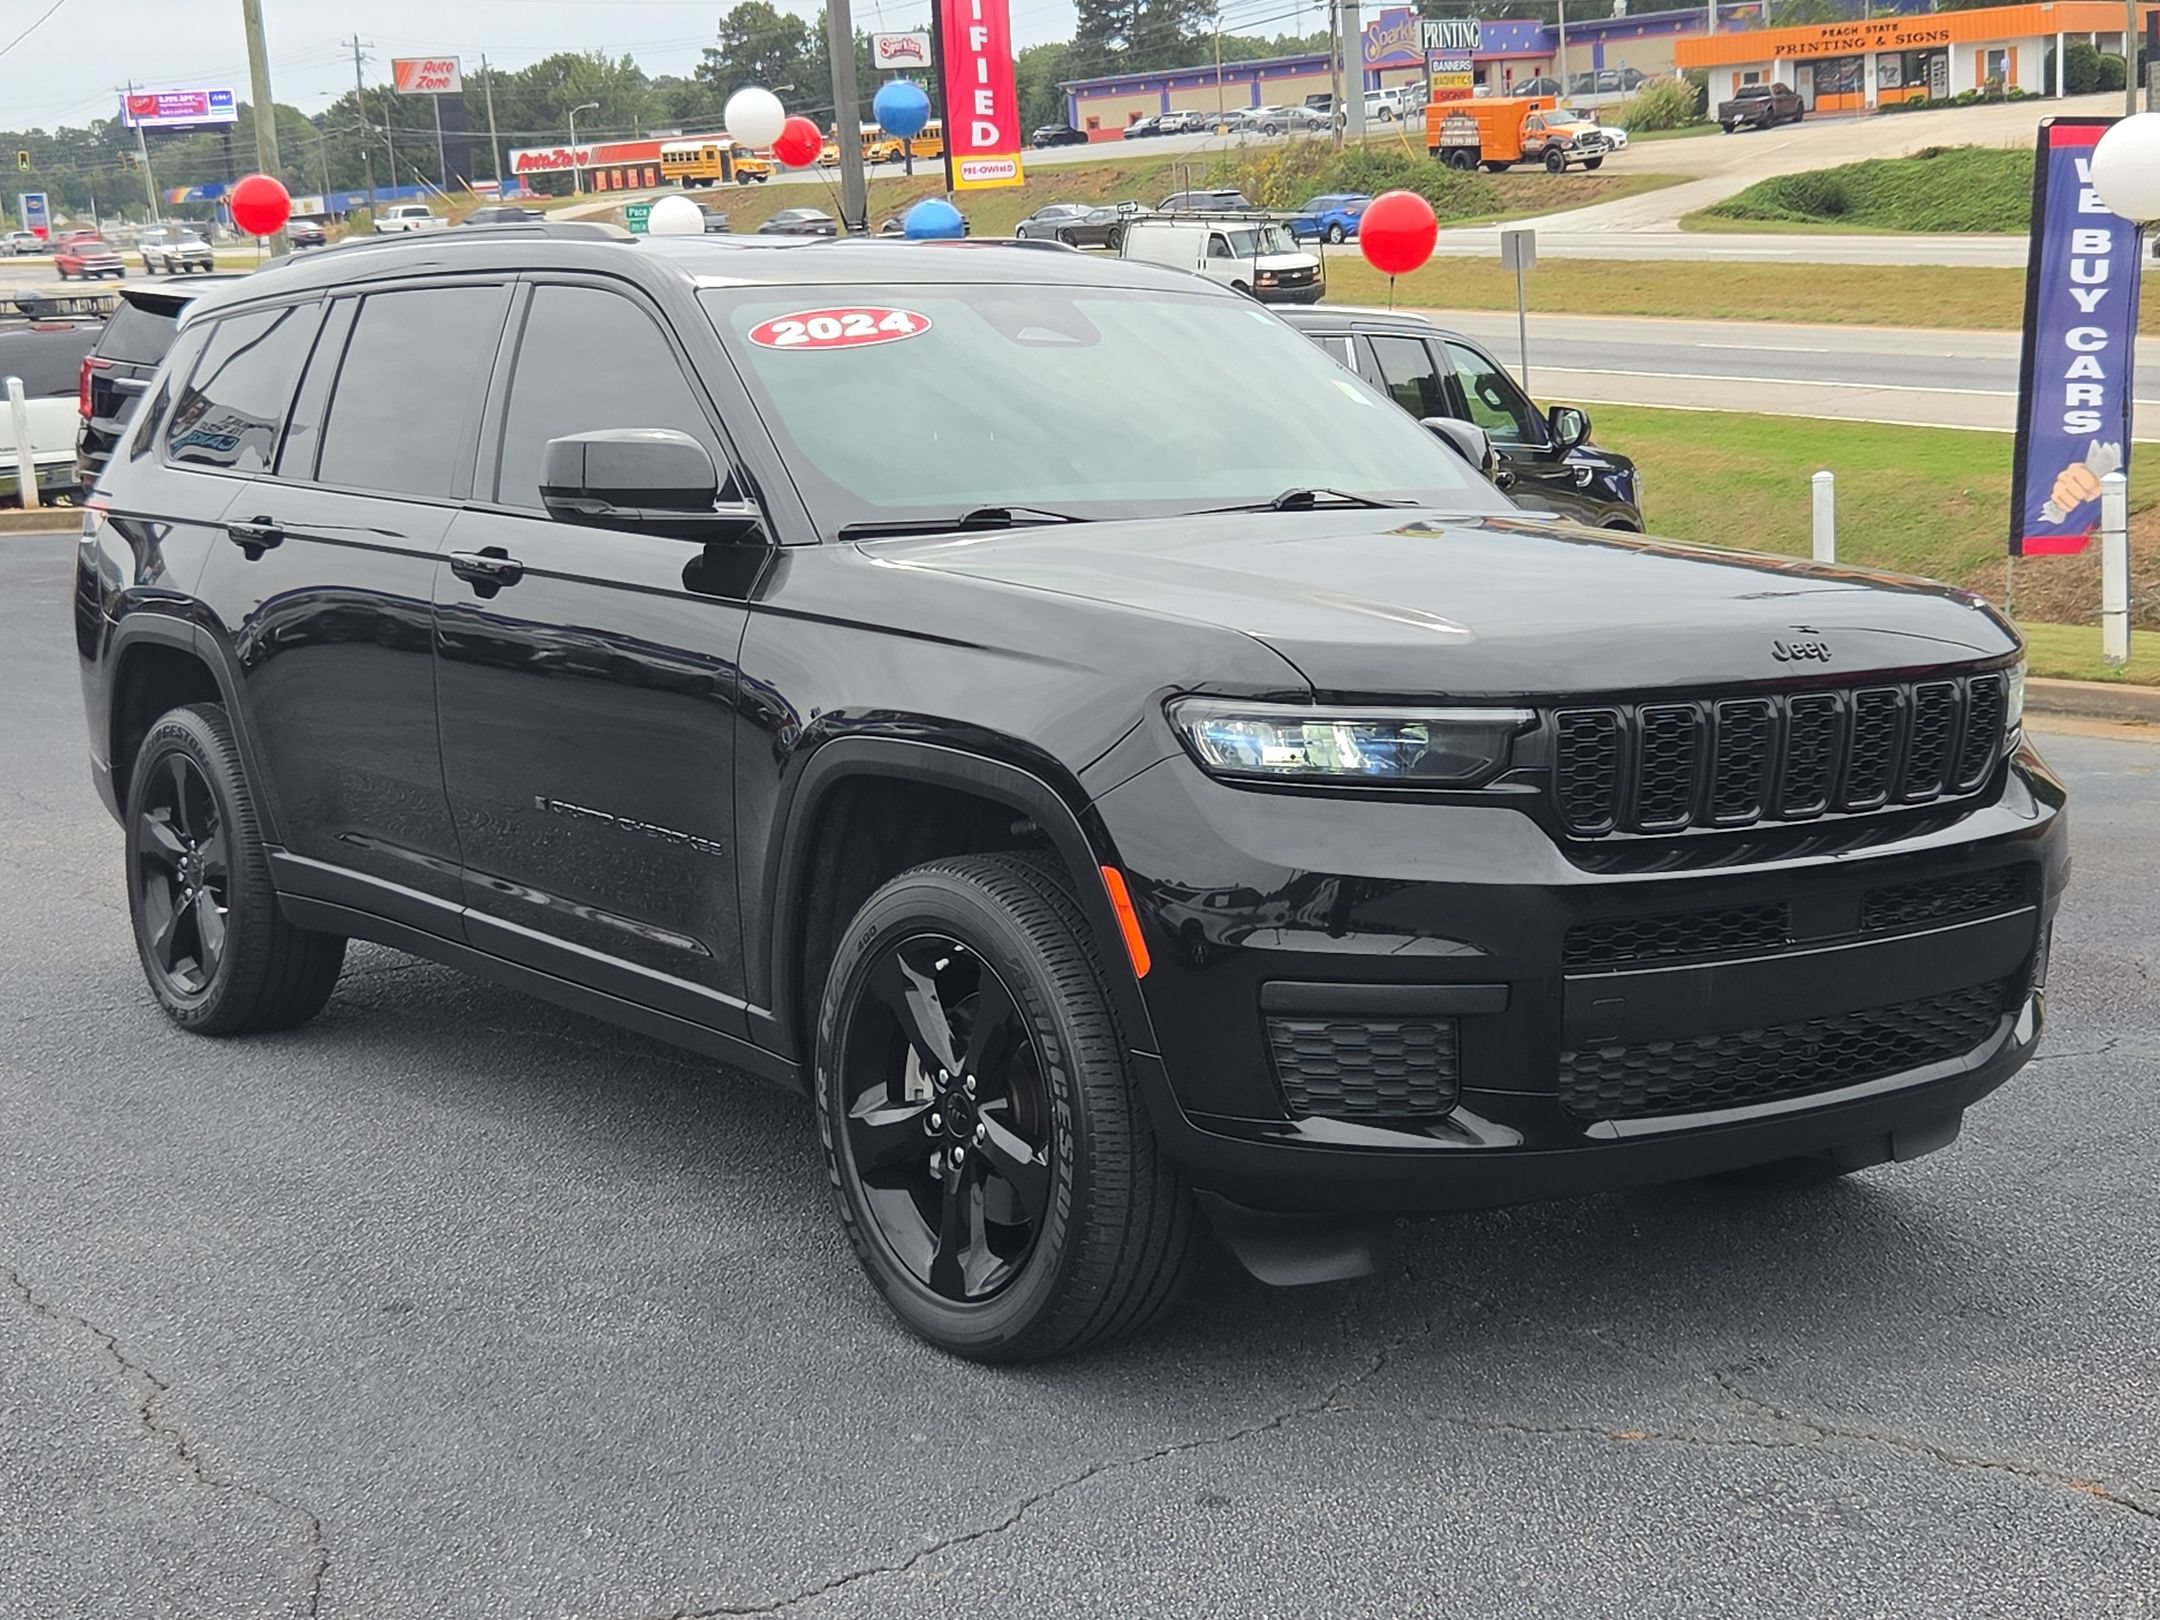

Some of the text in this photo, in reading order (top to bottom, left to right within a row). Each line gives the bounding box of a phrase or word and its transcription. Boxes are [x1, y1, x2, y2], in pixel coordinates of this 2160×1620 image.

[1422, 21, 1480, 49] PRINTING
[1773, 30, 1950, 55] PRINTING & SIGNS
[1821, 23, 1899, 38] PEACH STATE
[422, 60, 455, 74] Auto
[1432, 60, 1472, 72] BANNERS
[415, 75, 450, 89] Zone
[516, 149, 589, 172] AutoZone
[963, 164, 1014, 175] PRE-OWNED
[2068, 228, 2113, 313] BUY
[770, 311, 918, 346] 2024
[2062, 326, 2109, 435] CARS
[1771, 639, 1833, 663] Jeep
[857, 924, 878, 953] 400
